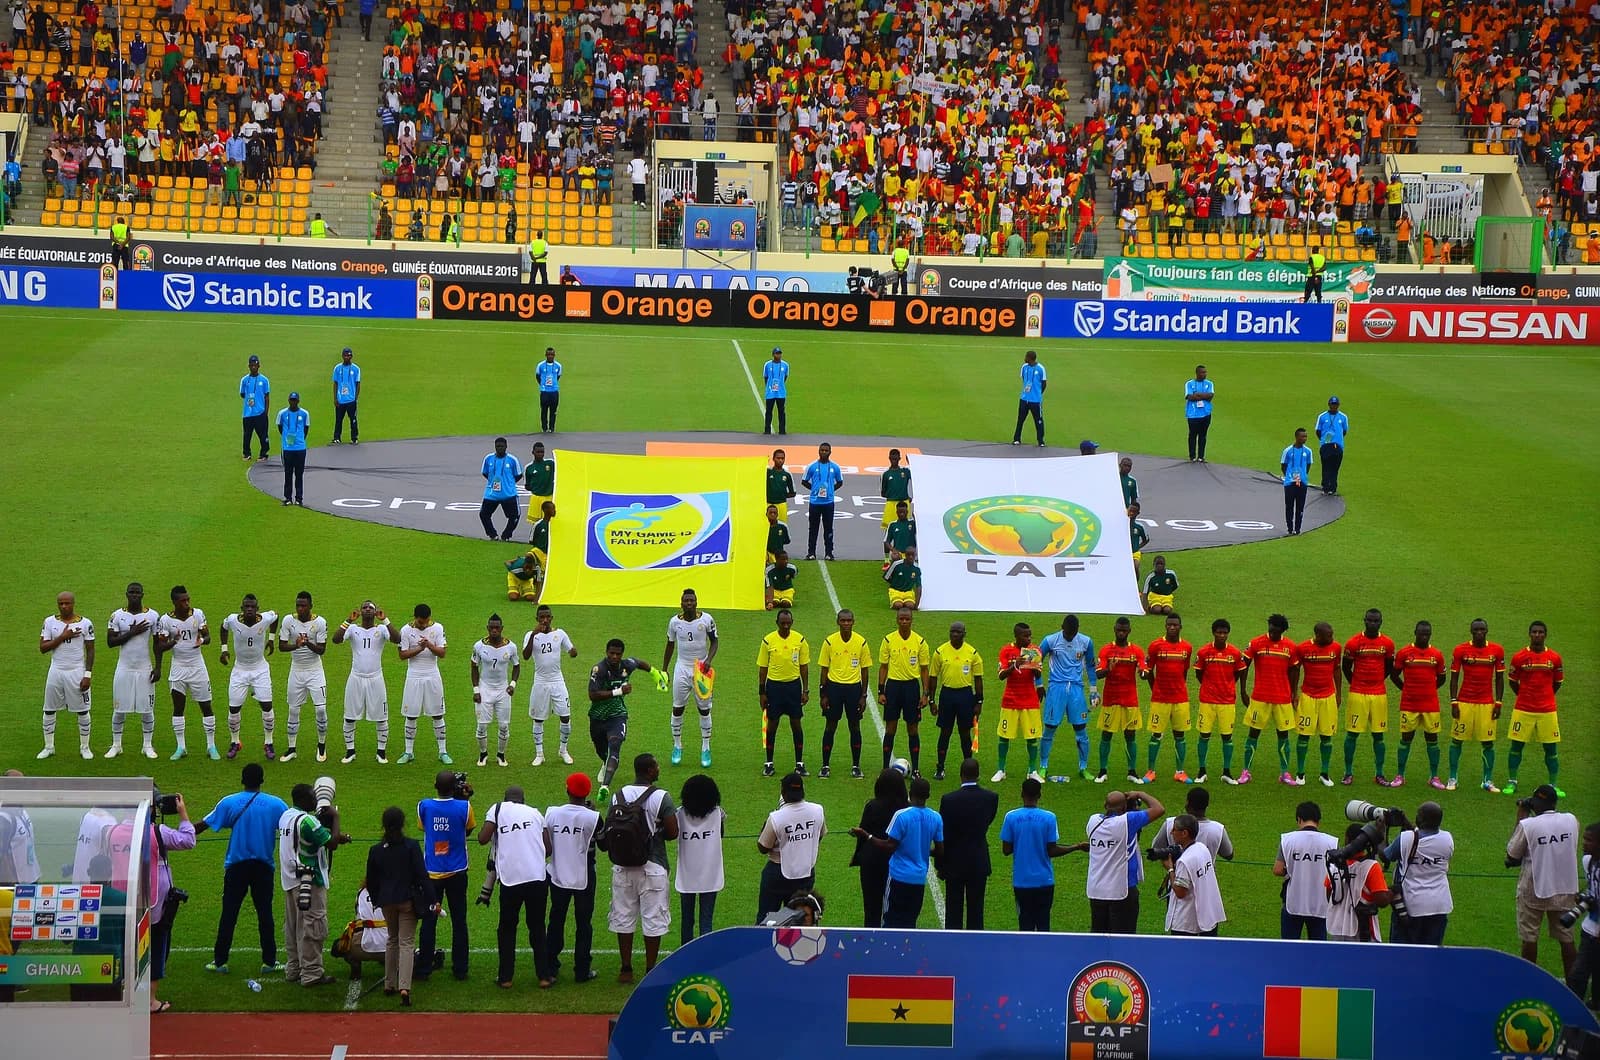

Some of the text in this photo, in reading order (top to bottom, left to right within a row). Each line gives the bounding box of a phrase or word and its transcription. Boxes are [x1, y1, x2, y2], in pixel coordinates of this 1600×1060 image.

[18, 247, 86, 263] ÉQUATORIALE
[88, 252, 113, 264] 2015
[163, 253, 203, 268] Coupe
[205, 255, 261, 270] d'Afrique
[264, 257, 287, 269] des
[291, 258, 337, 271] Nations
[341, 260, 388, 275] Orange,
[392, 260, 427, 274] GUINÉE
[429, 261, 494, 276] ÉQUATORIALE
[495, 265, 519, 277] 2015
[1147, 264, 1342, 285] Toujours fan des éléphts!
[949, 277, 987, 292] Coupe
[989, 278, 1043, 293] d'Afrique
[1045, 279, 1067, 291] des
[1072, 280, 1102, 292] Natio
[204, 281, 373, 311] Stanbic Bank
[1145, 291, 1180, 301] Comité
[1387, 285, 1442, 299] d'Afrique
[1445, 285, 1467, 297] des
[1472, 285, 1516, 297] Nations
[1575, 286, 1600, 298] GUIN
[442, 284, 555, 319] Orange
[601, 289, 713, 324] Orange
[747, 293, 859, 328] Orange
[905, 299, 1016, 334] Orange
[1113, 307, 1301, 335] Standard Bank
[1408, 310, 1588, 340] NISSAN
[643, 537, 676, 545] PLAY
[681, 552, 724, 566] FIFA
[966, 558, 1085, 578] CAF
[181, 630, 192, 641] 21
[687, 631, 694, 642] 3
[247, 637, 253, 647] 6
[362, 637, 371, 649] 11
[540, 642, 553, 654] 23
[492, 658, 498, 669] 7
[1298, 716, 1311, 727] 20
[1401, 712, 1408, 724] 5
[1002, 719, 1008, 730] 8
[1454, 723, 1466, 734] 23
[1512, 720, 1521, 732] 10
[433, 823, 450, 832] 092
[500, 821, 533, 834] CAF
[552, 824, 583, 835] CAF
[784, 821, 815, 834] CAF
[682, 830, 713, 840] CAF
[1537, 833, 1570, 846] CAF
[112, 843, 131, 853] CA
[1090, 838, 1117, 849] CAF
[1292, 853, 1323, 863] CAF
[25, 963, 82, 976] GHANA
[1075, 968, 1142, 1015] GUINÉE ÉQUATORIALE 2015
[1083, 1025, 1132, 1037] CAF
[671, 1031, 724, 1044] CAF
[1097, 1042, 1121, 1051] COUPE
[1097, 1051, 1134, 1059] D'AFRIQUE
